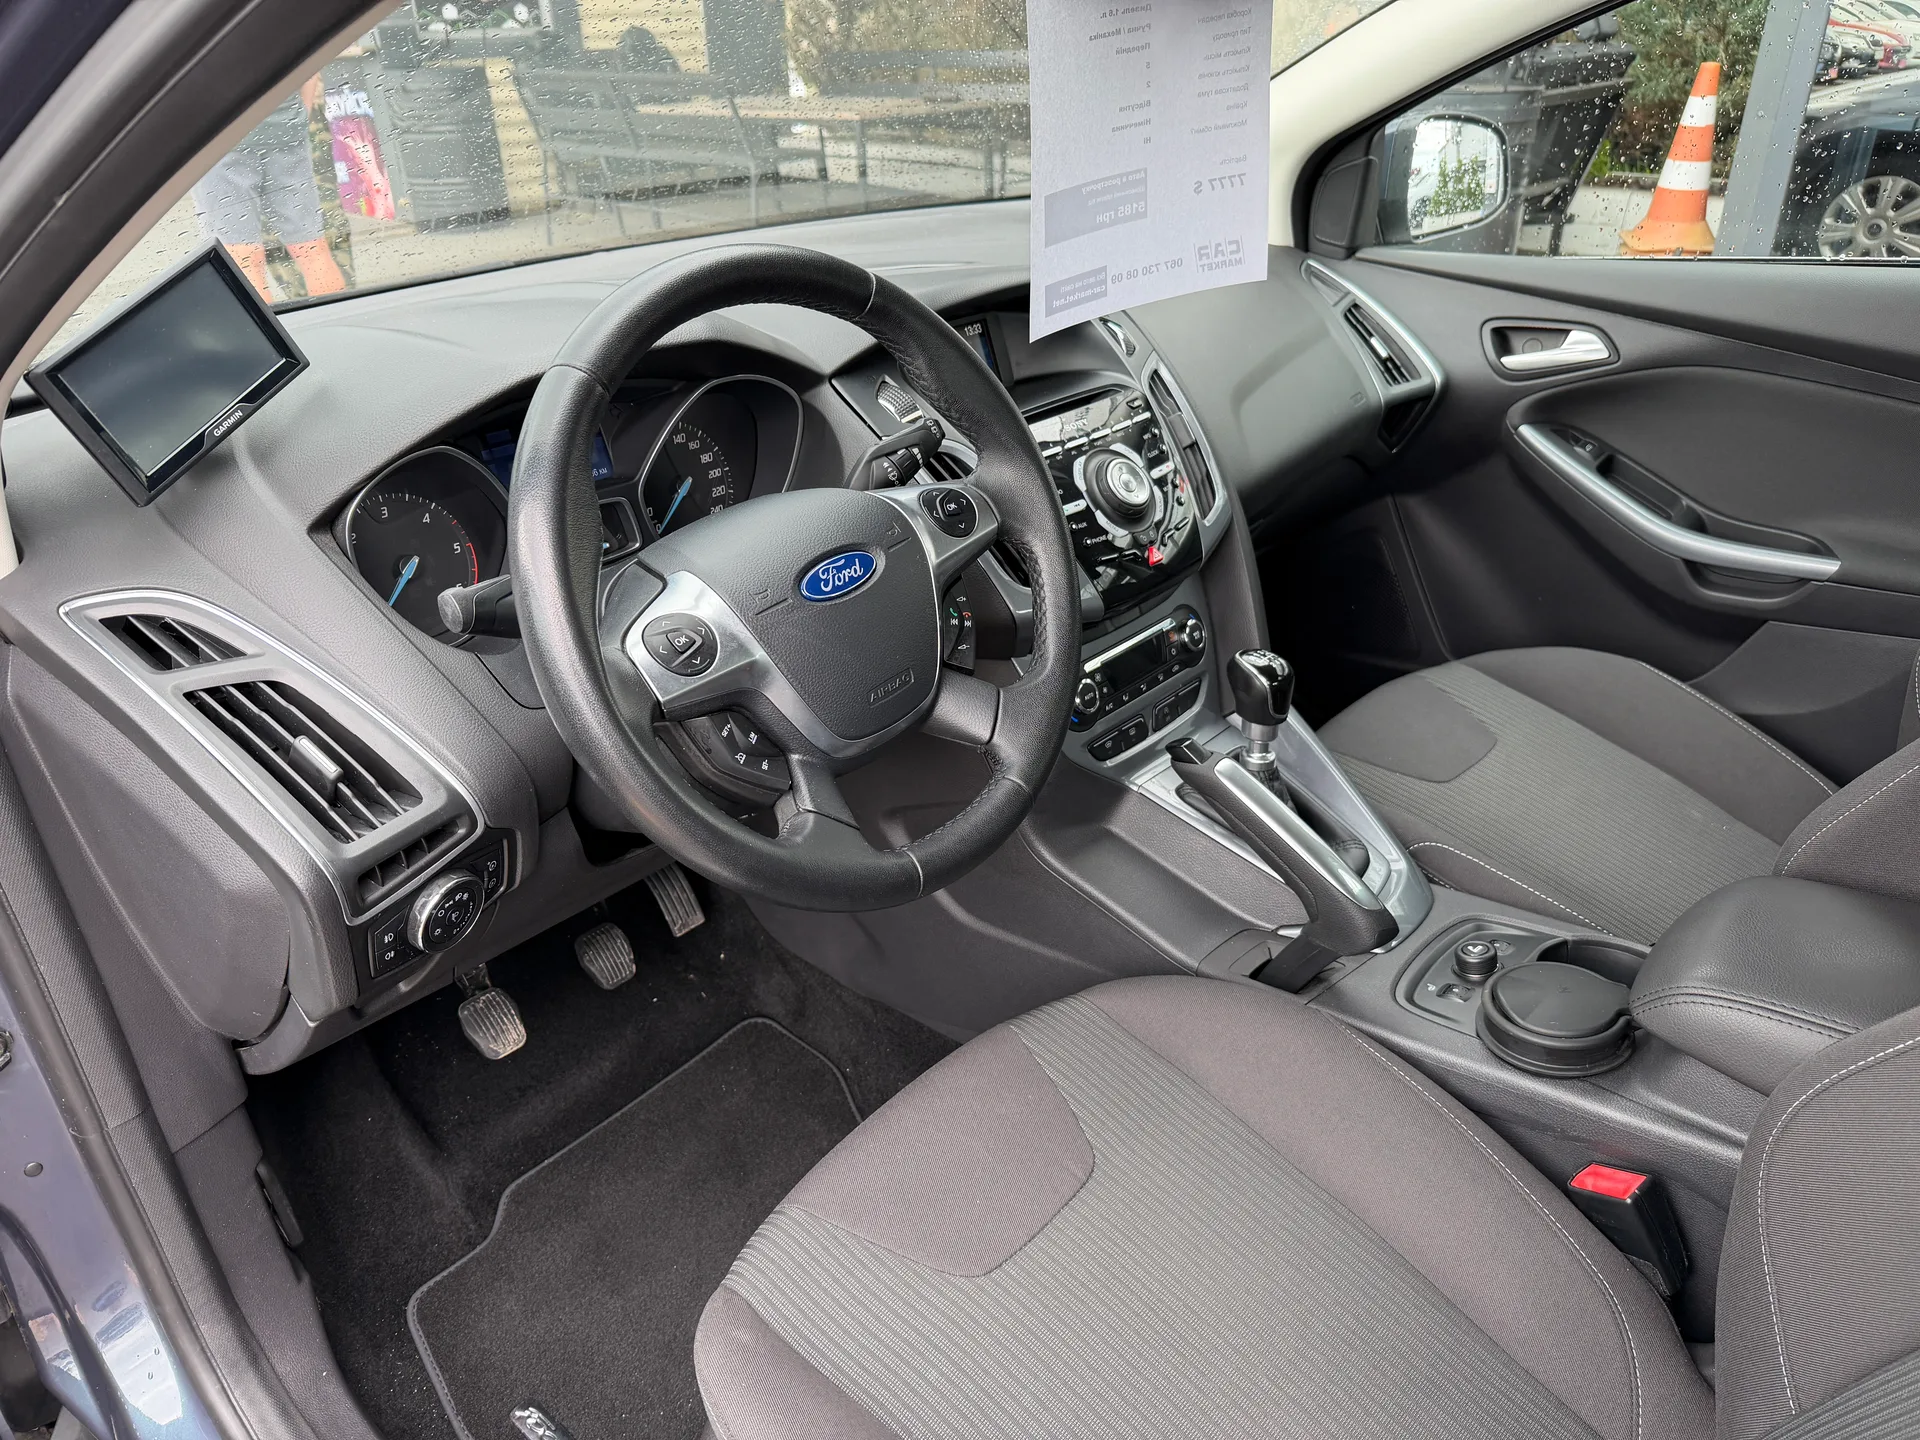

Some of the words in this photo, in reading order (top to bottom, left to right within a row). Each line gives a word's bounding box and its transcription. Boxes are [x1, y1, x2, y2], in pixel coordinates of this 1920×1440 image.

[213, 409, 243, 437] GARMIN
[1064, 418, 1088, 432] SONY
[673, 433, 686, 445] 140
[688, 440, 700, 451] 160
[700, 452, 713, 464] 180
[708, 467, 722, 479] 200
[712, 485, 726, 498] 220
[380, 506, 389, 519] 3
[946, 502, 958, 511] OK
[422, 512, 431, 524] 4
[453, 542, 461, 554] 5
[818, 558, 864, 592] Ford
[674, 634, 690, 646] OK
[869, 671, 911, 703] AIRBAG
